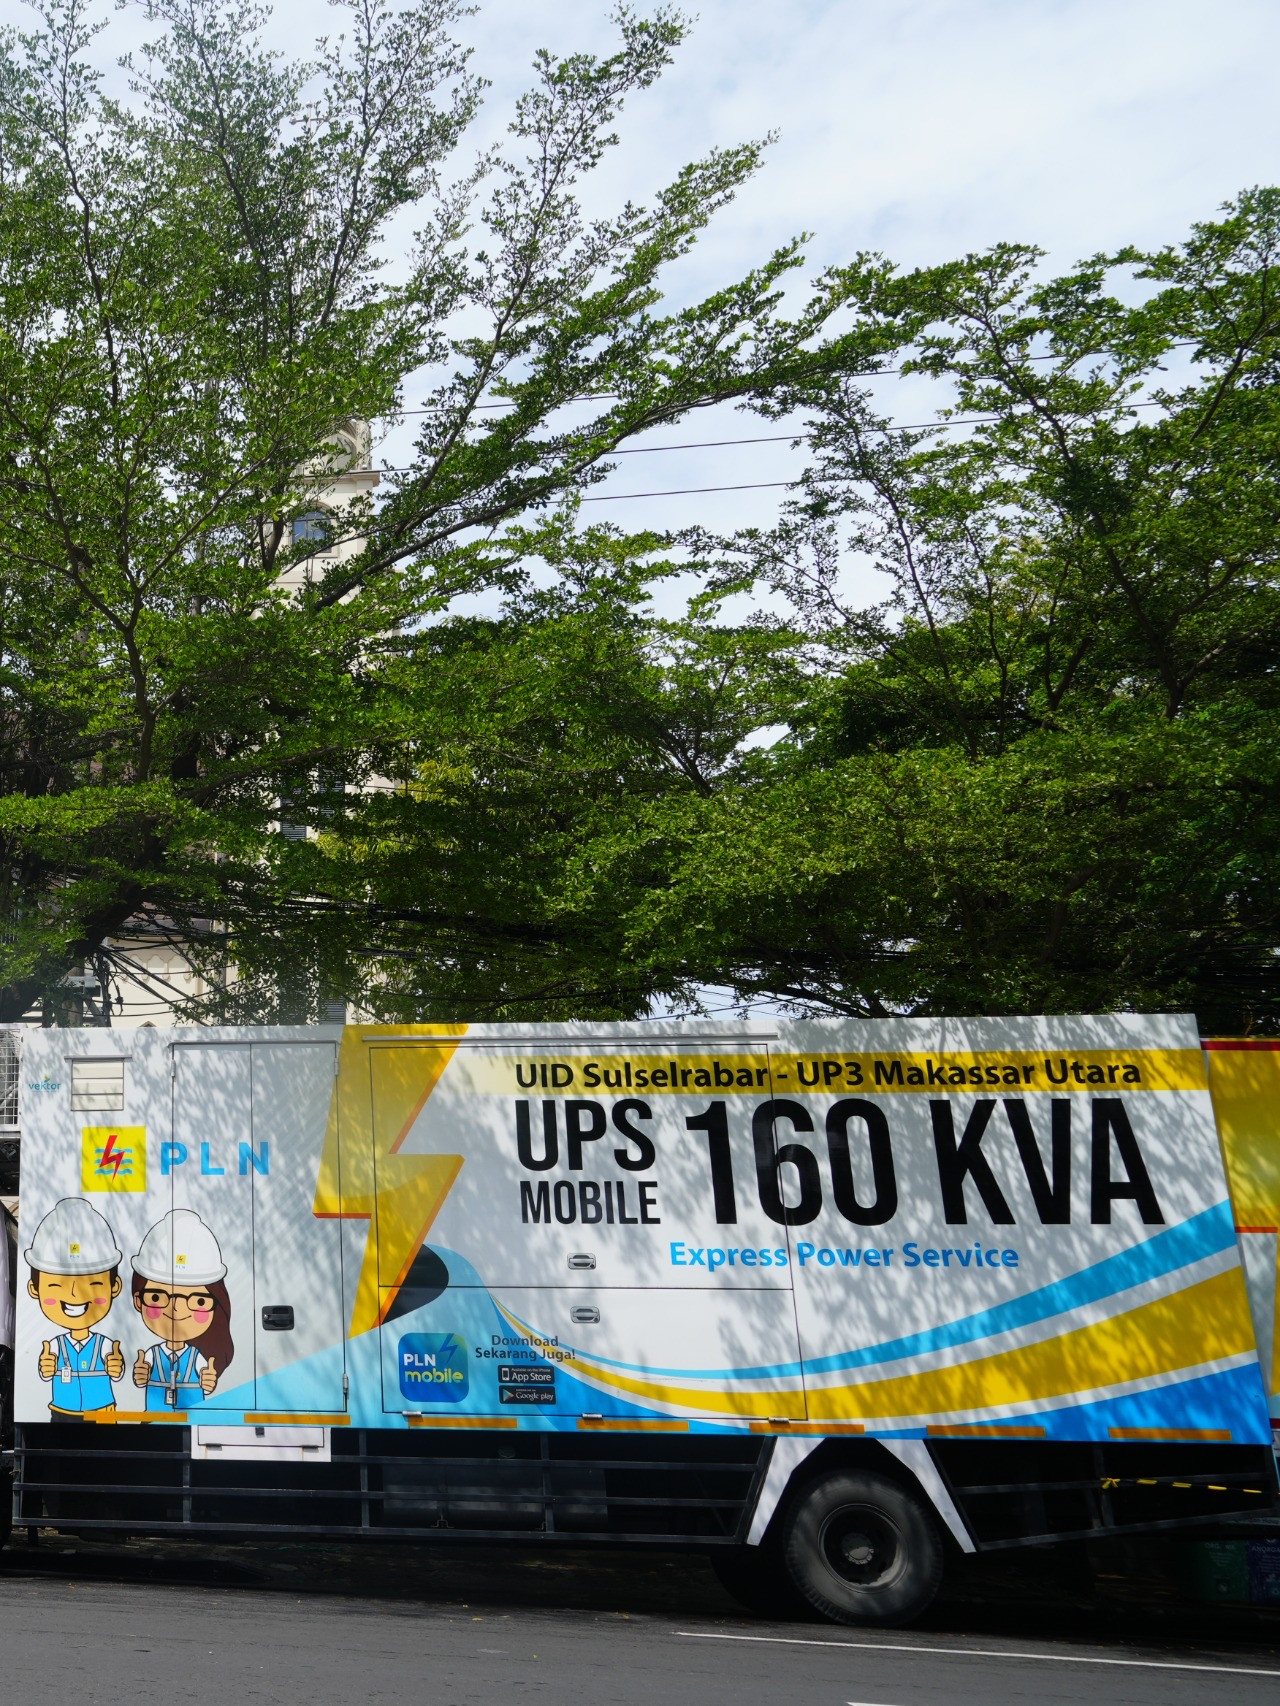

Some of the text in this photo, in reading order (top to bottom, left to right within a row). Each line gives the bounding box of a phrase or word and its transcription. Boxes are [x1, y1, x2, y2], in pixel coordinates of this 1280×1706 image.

[516, 1063, 574, 1088] UID
[583, 1061, 768, 1088] Sulselrabar
[797, 1060, 864, 1086] UP3
[874, 1060, 1035, 1085] Makassar
[1044, 1059, 1141, 1084] Utara
[28, 1081, 61, 1091] vektor
[161, 1141, 269, 1176] PLN
[514, 1098, 1166, 1227] UPS 160 KVA
[520, 1180, 661, 1225] MOBILE
[669, 1242, 1019, 1272] Express Power Service
[491, 1335, 559, 1347] Download
[403, 1353, 437, 1367] PLN
[475, 1347, 576, 1363] Sekarang Juga!
[404, 1368, 464, 1384] mobile
[511, 1372, 552, 1382] App Store
[515, 1391, 554, 1401] Google play
